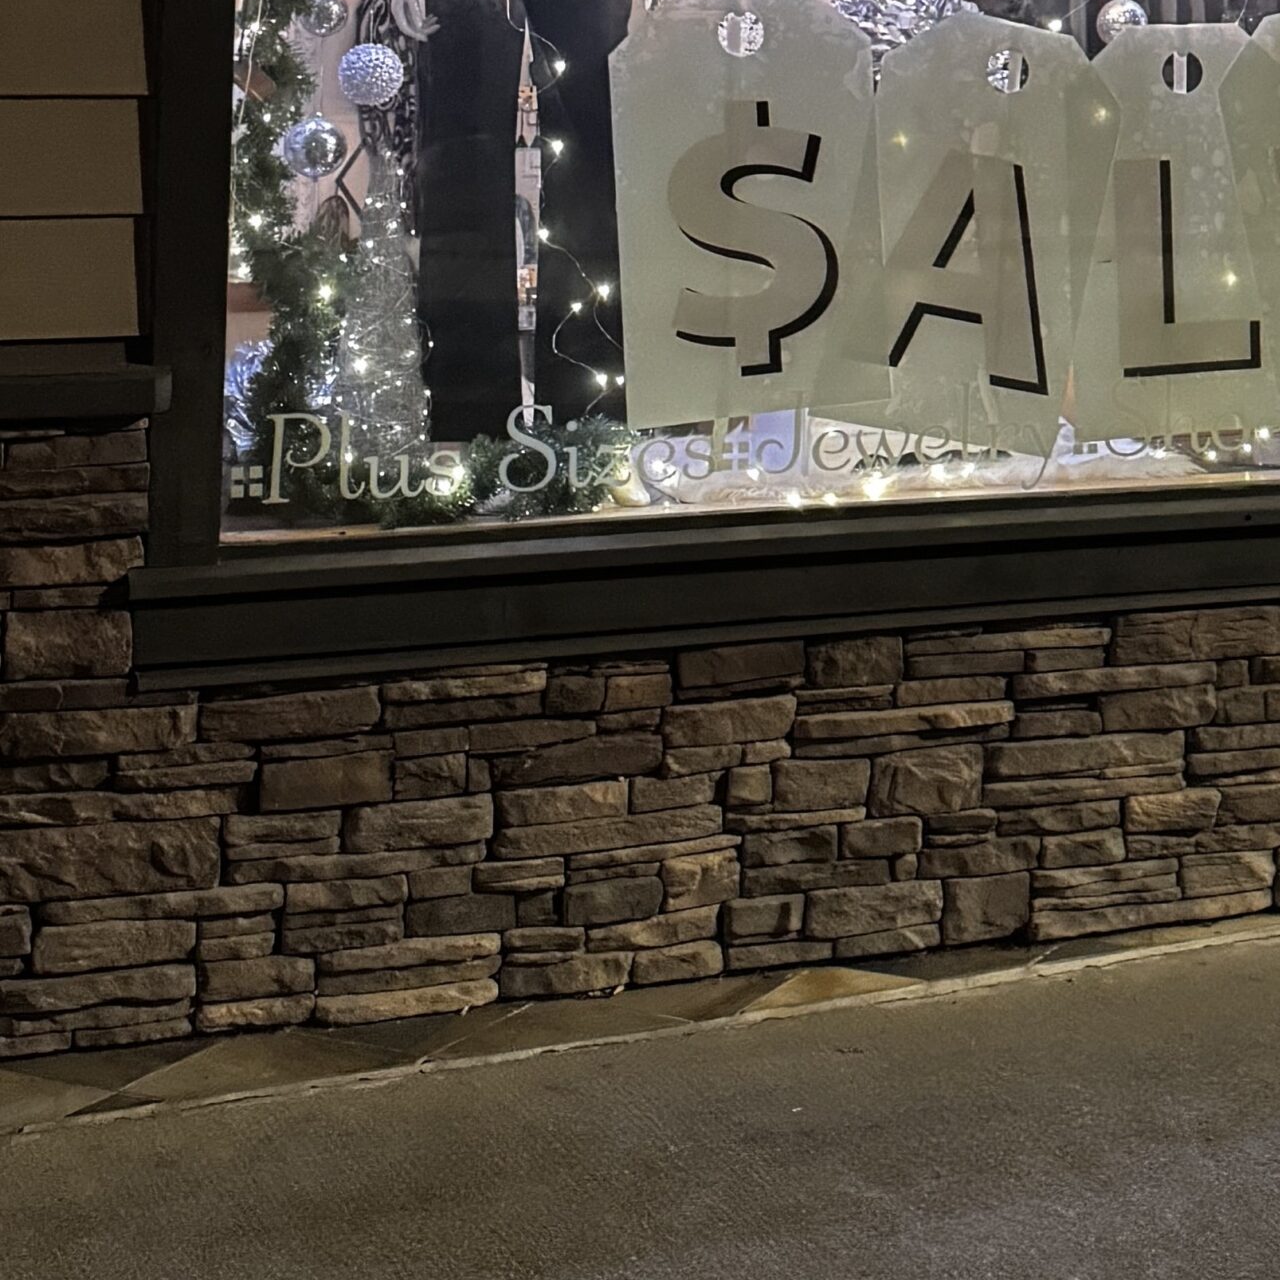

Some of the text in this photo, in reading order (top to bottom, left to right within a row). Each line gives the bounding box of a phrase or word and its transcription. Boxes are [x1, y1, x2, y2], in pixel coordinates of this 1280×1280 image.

[261, 408, 466, 505] Plus
[499, 404, 715, 493] Sizes
[755, 380, 1057, 491] Jewelry
